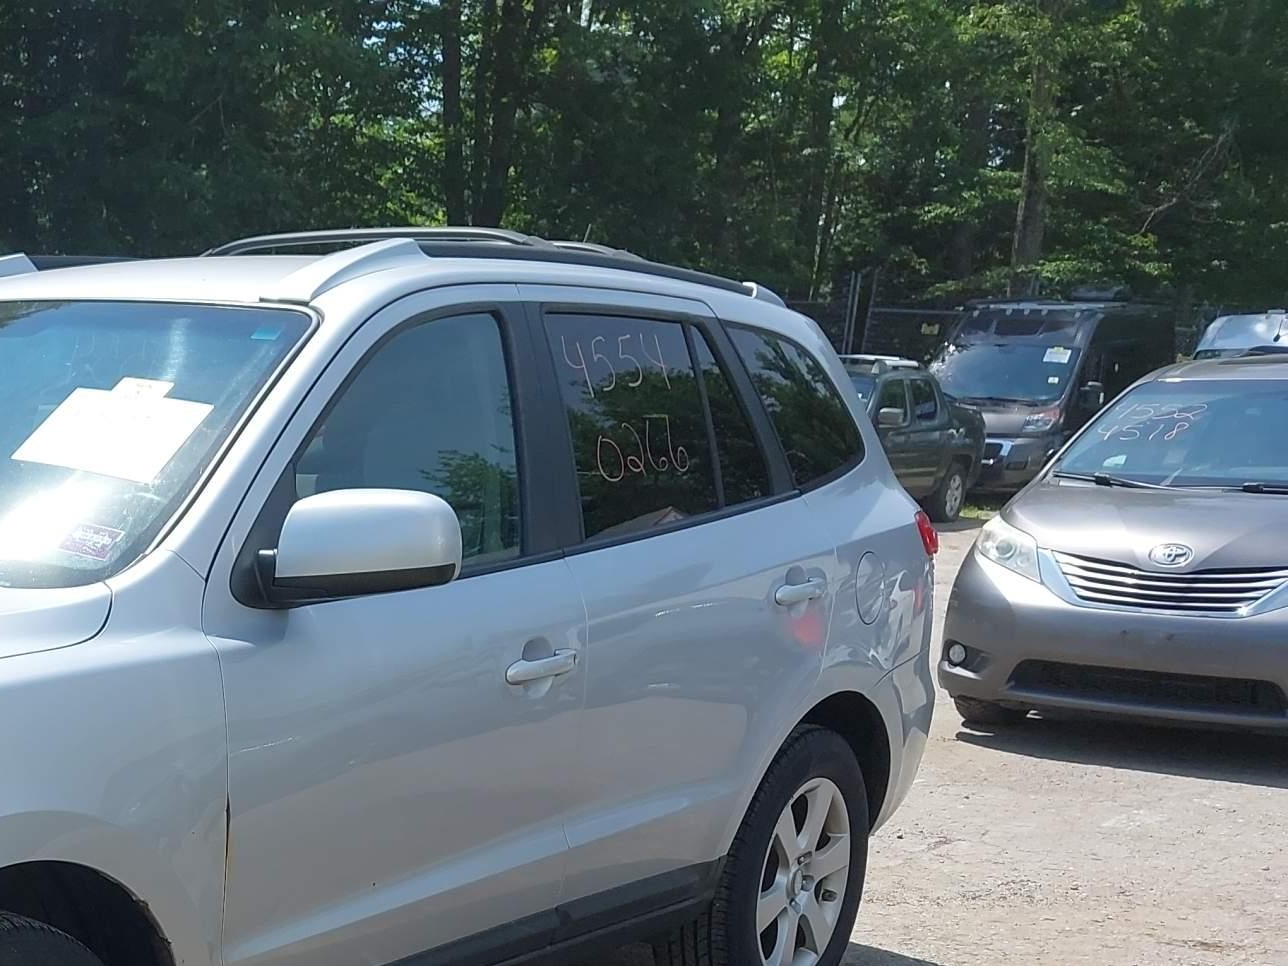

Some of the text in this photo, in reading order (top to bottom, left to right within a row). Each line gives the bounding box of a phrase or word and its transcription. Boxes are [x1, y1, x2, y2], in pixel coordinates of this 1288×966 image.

[561, 332, 672, 397] 4554
[597, 414, 690, 482] 0266
[1097, 422, 1190, 441] 4518
